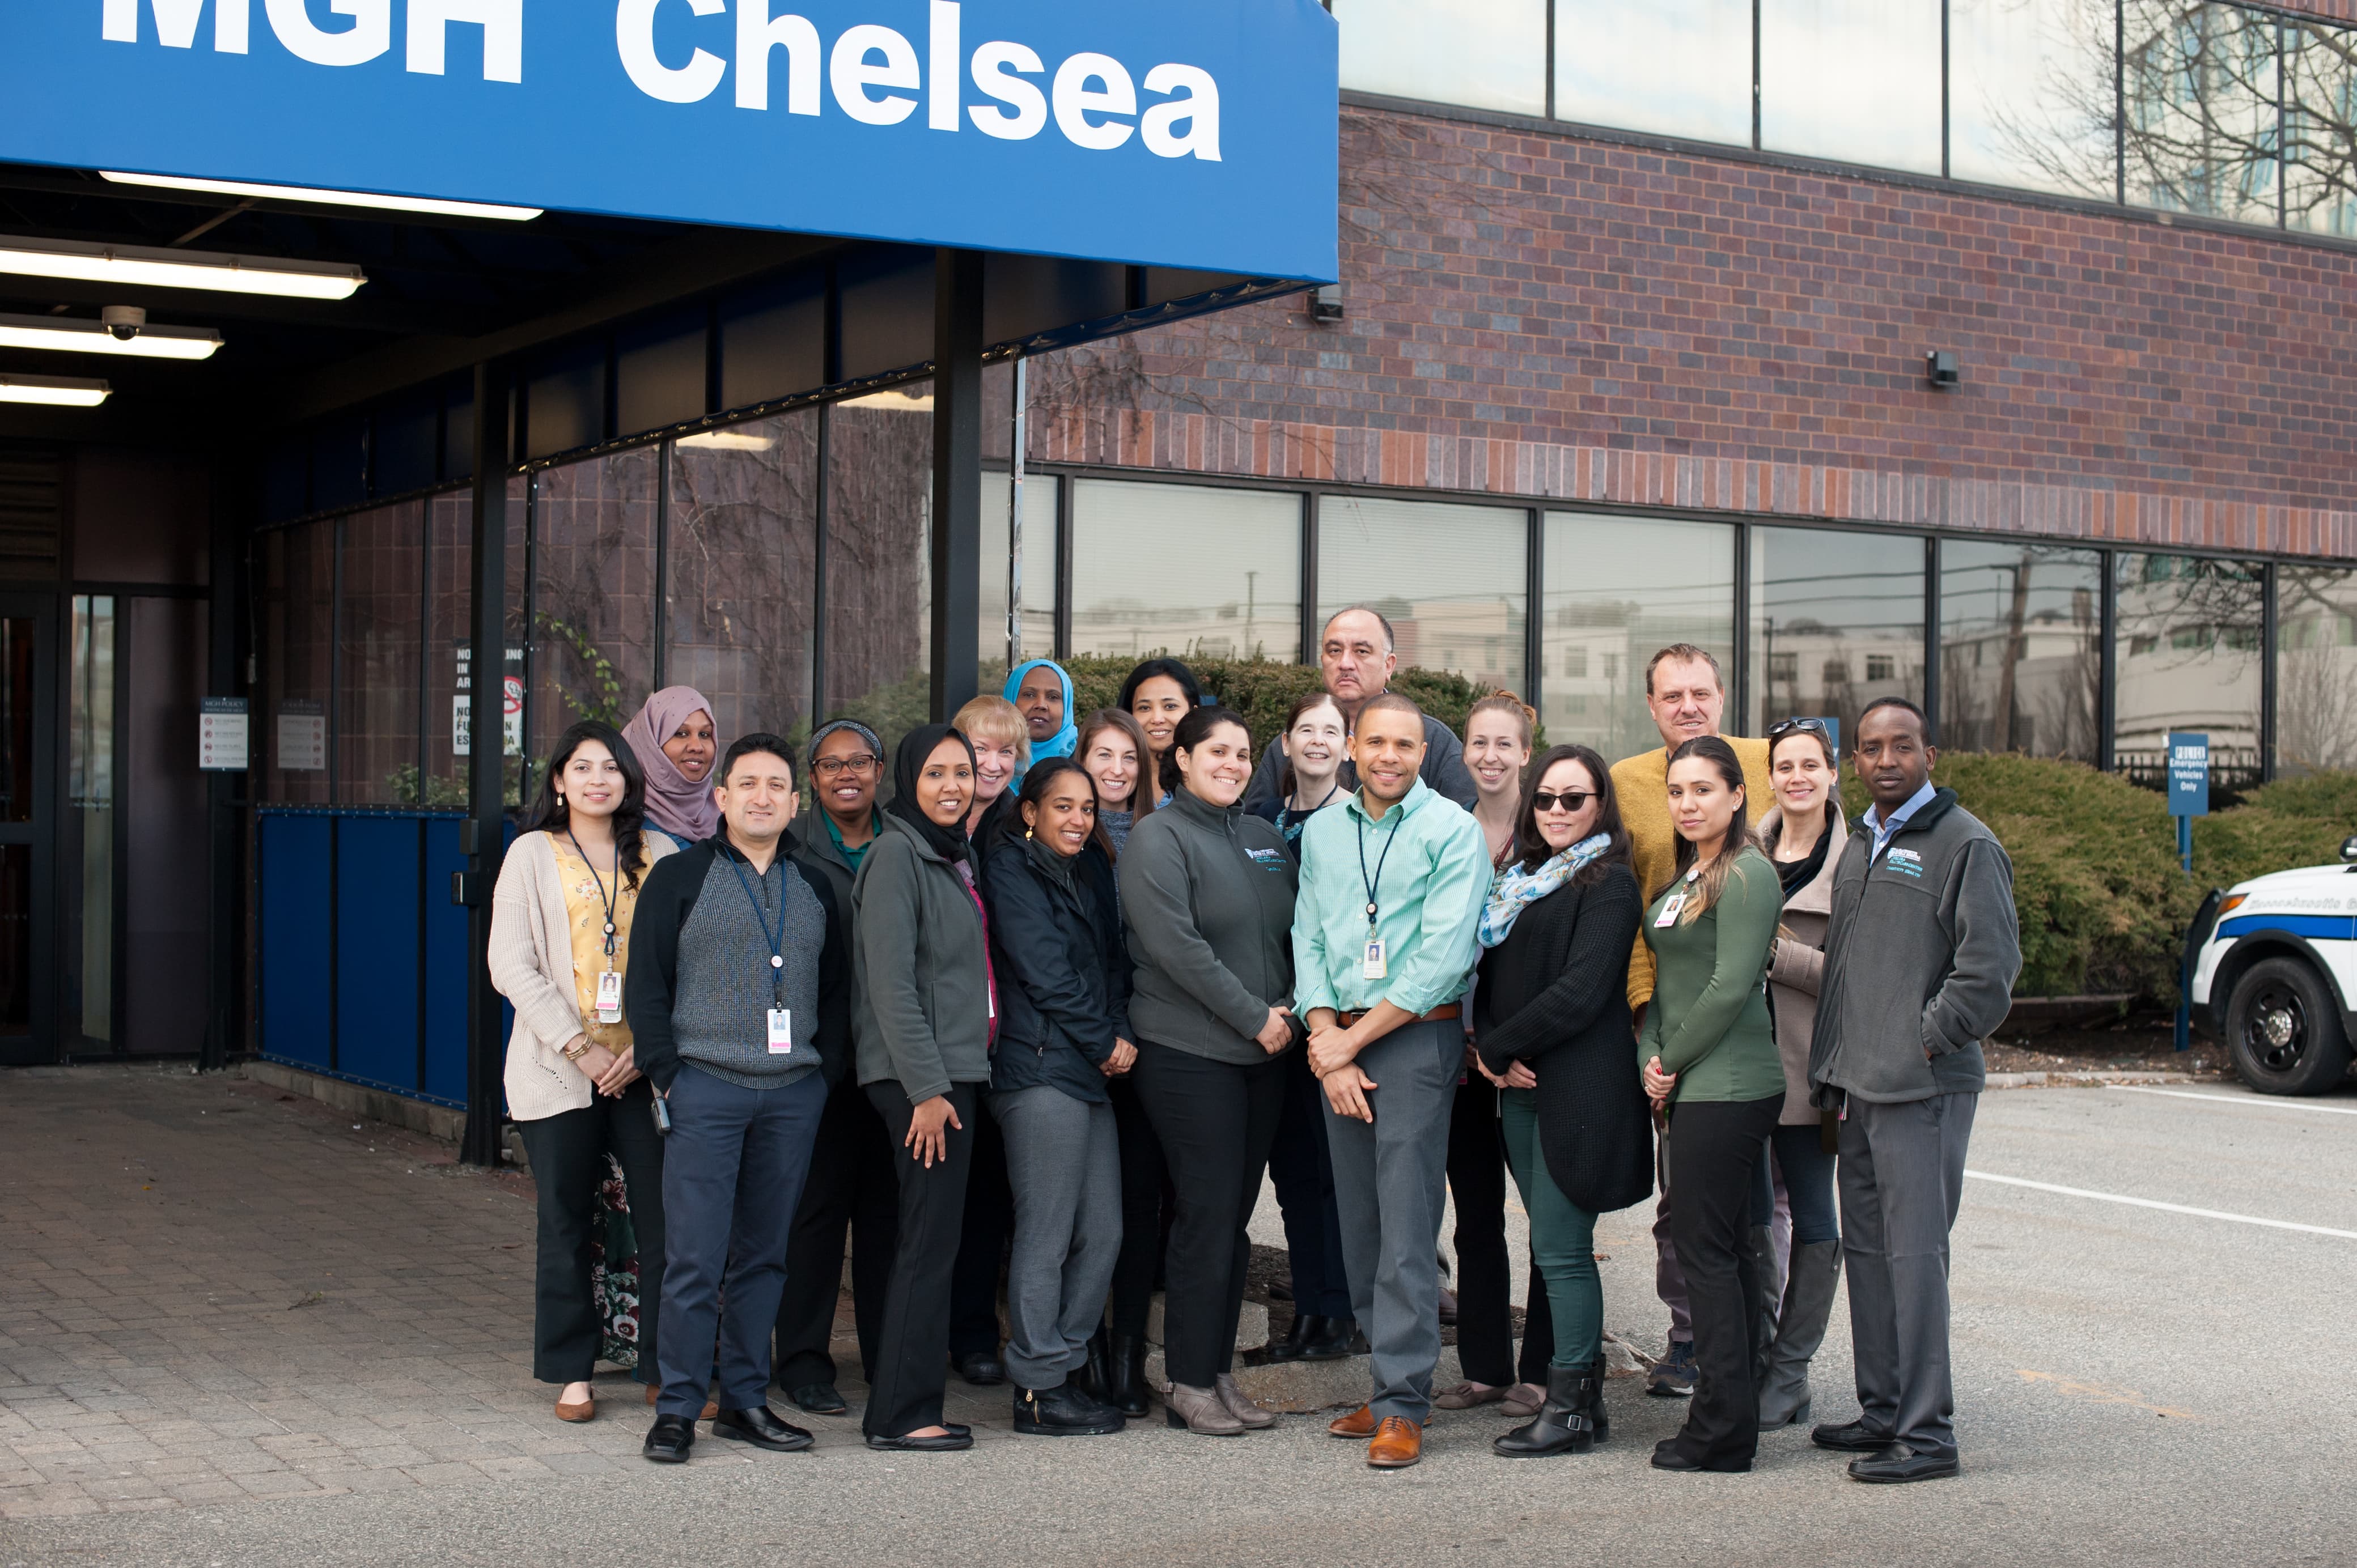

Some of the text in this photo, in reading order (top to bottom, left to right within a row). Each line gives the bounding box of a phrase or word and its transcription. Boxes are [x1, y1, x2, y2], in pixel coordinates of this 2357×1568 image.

[616, 0, 1222, 162] Chelsea
[457, 664, 468, 674] IN
[456, 677, 470, 688] AR
[2169, 758, 2208, 770] Emergency
[2174, 770, 2203, 780] Vehicles
[2180, 781, 2197, 793] Only
